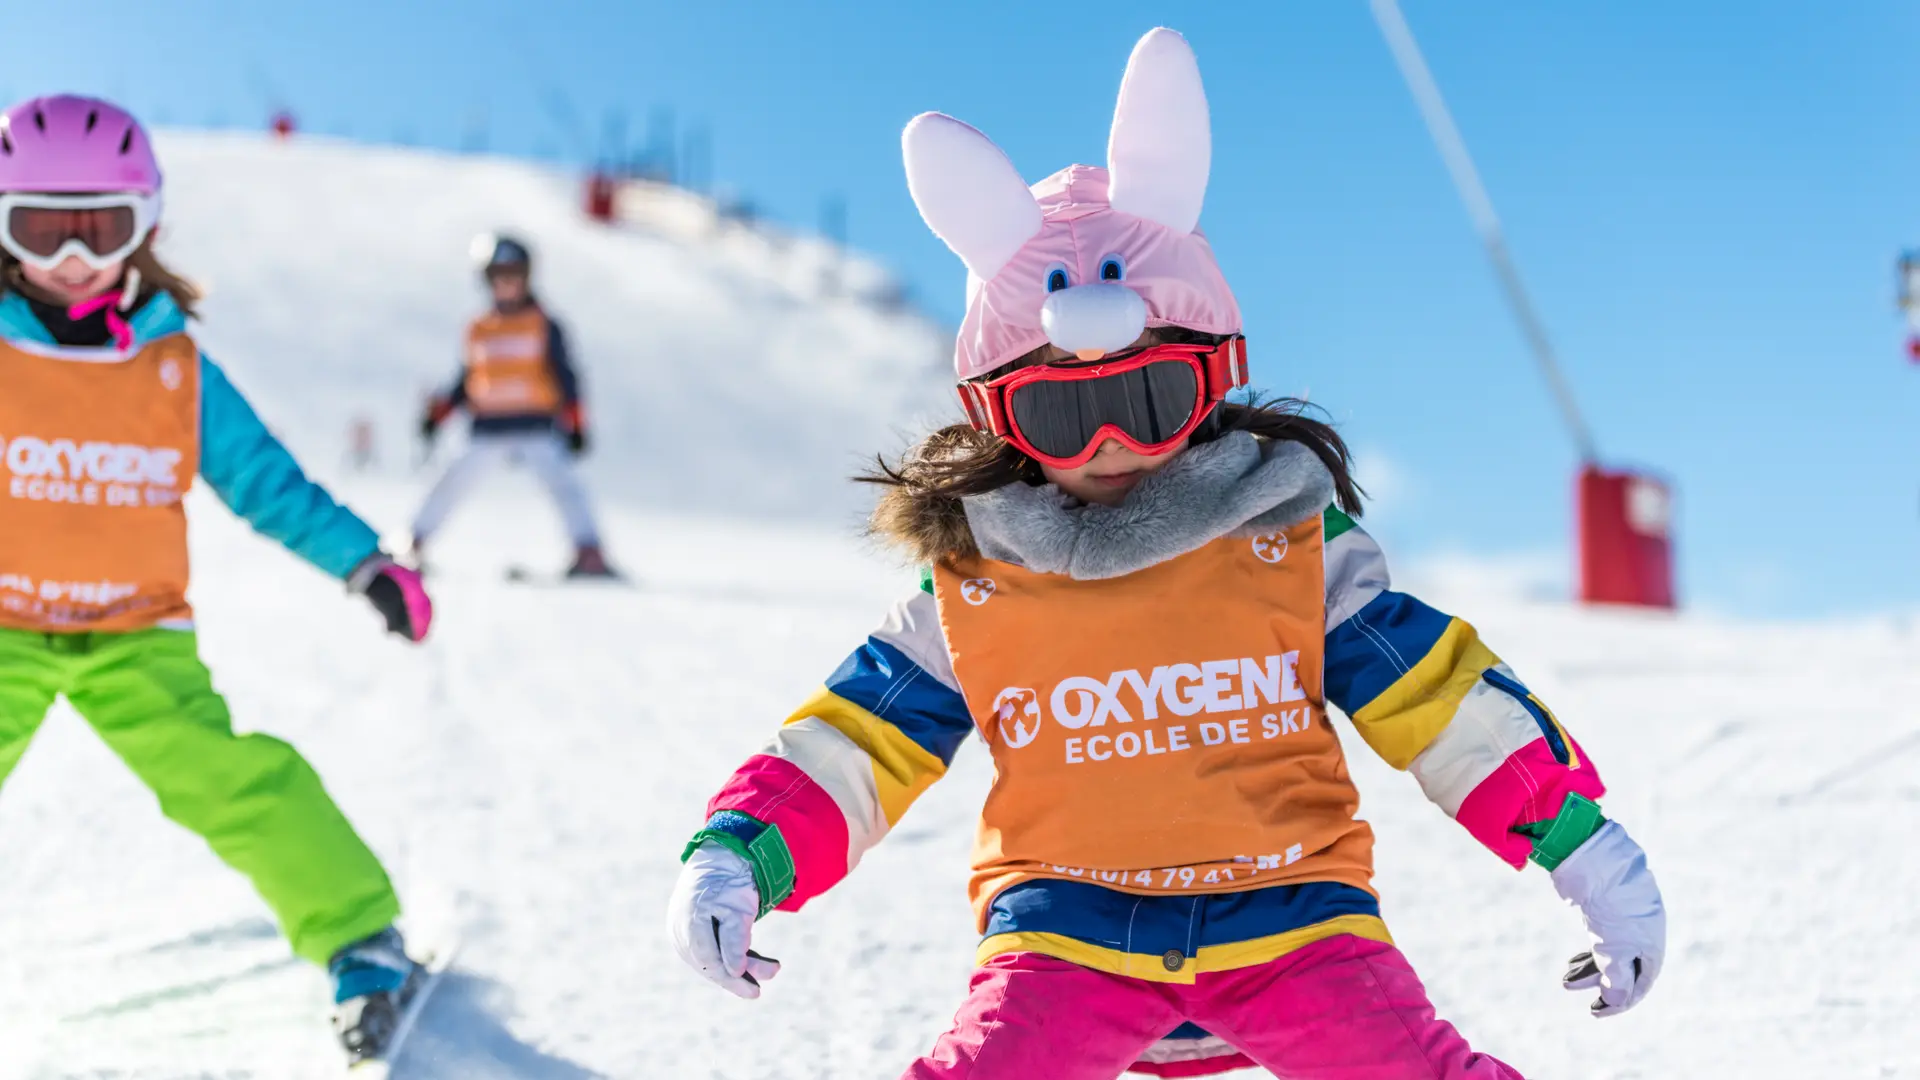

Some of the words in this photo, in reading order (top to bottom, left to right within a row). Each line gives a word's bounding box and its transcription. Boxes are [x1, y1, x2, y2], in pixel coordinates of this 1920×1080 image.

[7, 436, 182, 485] OXYGENE
[10, 475, 99, 505] ECOLE
[1050, 650, 1306, 730] OXYGENE
[1065, 725, 1190, 764] ECOLE
[1200, 718, 1250, 746] DE
[1262, 706, 1310, 739] SKI
[1203, 867, 1236, 884] 41
